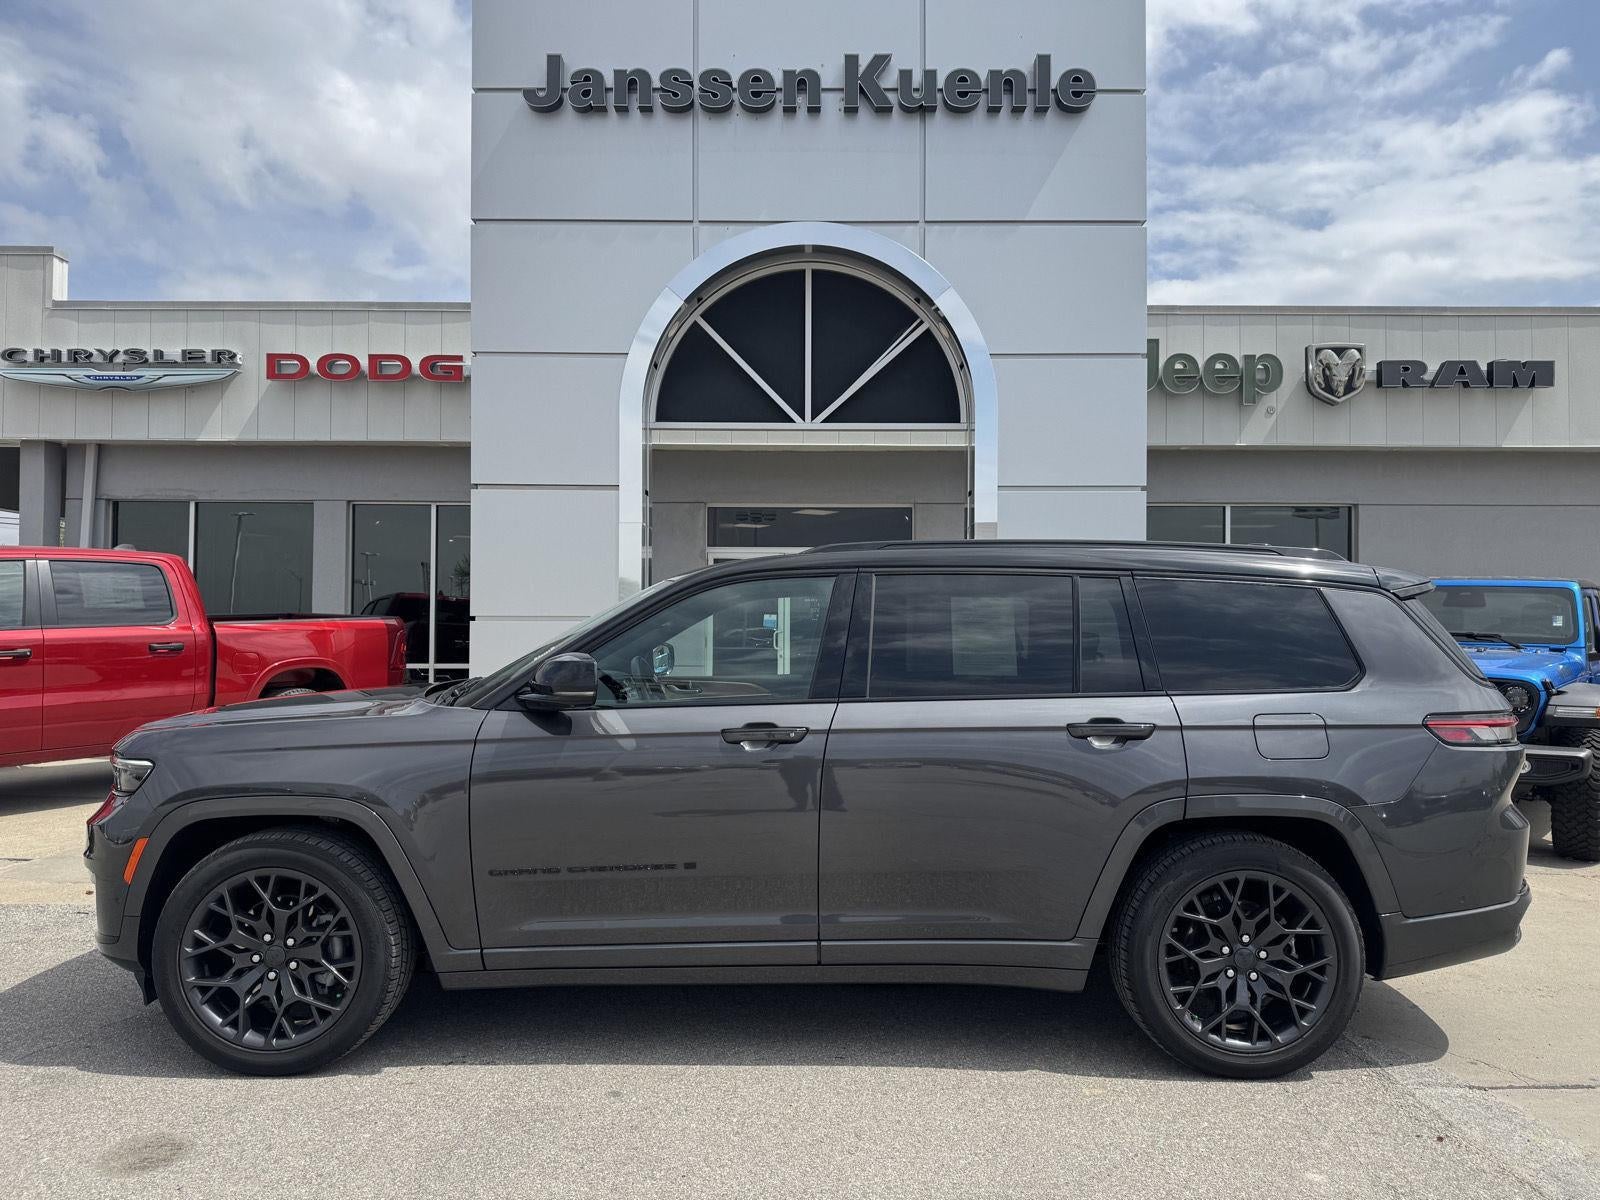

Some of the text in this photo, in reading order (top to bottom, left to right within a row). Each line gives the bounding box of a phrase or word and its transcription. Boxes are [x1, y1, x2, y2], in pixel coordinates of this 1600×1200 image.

[522, 53, 1097, 114] Janssen Kuenle
[0, 347, 242, 365] CHRYSLER
[266, 353, 465, 382] DODG
[1377, 359, 1556, 389] RAM
